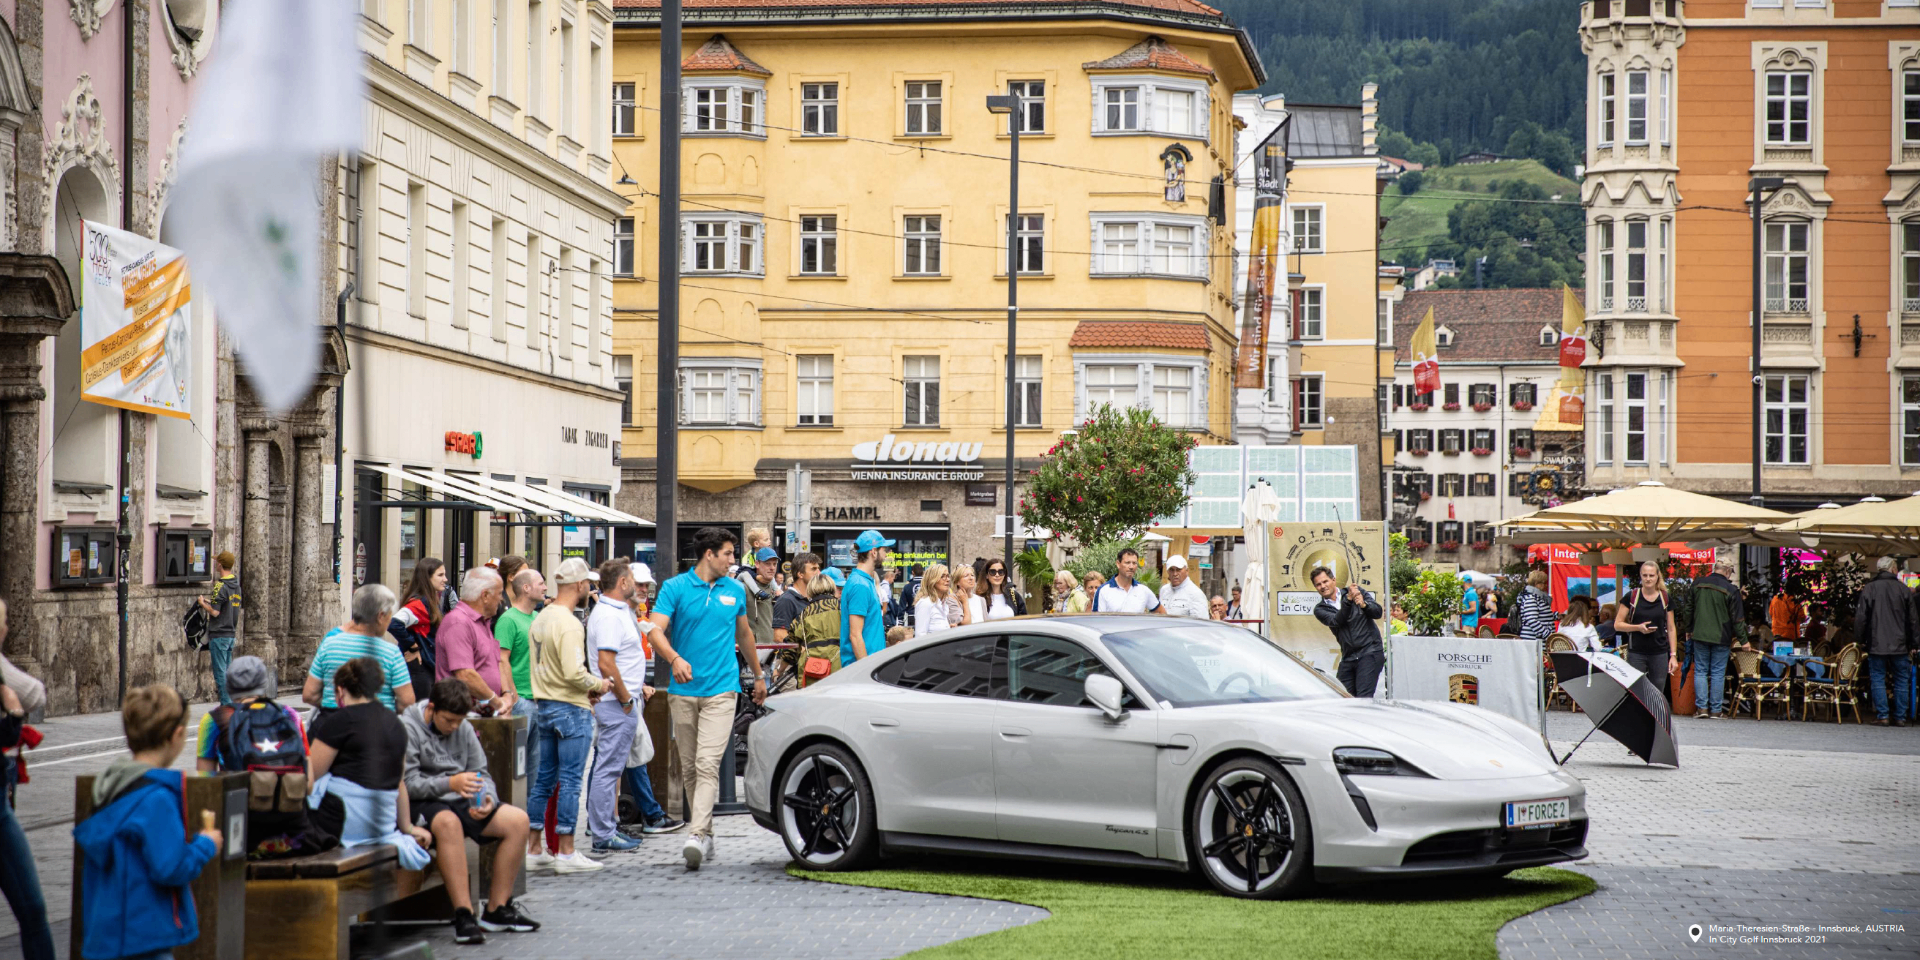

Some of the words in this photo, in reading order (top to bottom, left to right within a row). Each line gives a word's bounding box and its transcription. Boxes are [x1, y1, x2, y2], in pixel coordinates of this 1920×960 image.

[1259, 167, 1270, 177] Alt
[1258, 178, 1278, 189] Stadt
[121, 258, 157, 290] HIGHLIGHTS
[1256, 269, 1265, 290] Sie
[1254, 291, 1264, 312] für
[1253, 313, 1262, 341] sind
[1248, 341, 1260, 372] Wir
[445, 431, 476, 454] SPAR
[561, 426, 578, 444] TABAK
[585, 430, 609, 449] ZIGARREN
[851, 434, 984, 462] donau
[851, 471, 888, 481] VIENNA
[890, 471, 948, 481] INSURANCE
[950, 471, 984, 481] GROUP
[825, 506, 881, 520] HAMPL
[903, 551, 935, 559] einkaufen
[936, 551, 947, 559] bei
[1693, 550, 1712, 559] 1931
[1280, 604, 1291, 612] In
[1293, 604, 1312, 614] City
[1438, 653, 1492, 663] PORSCHE
[1528, 802, 1559, 821] FORCE
[1559, 801, 1565, 818] 2
